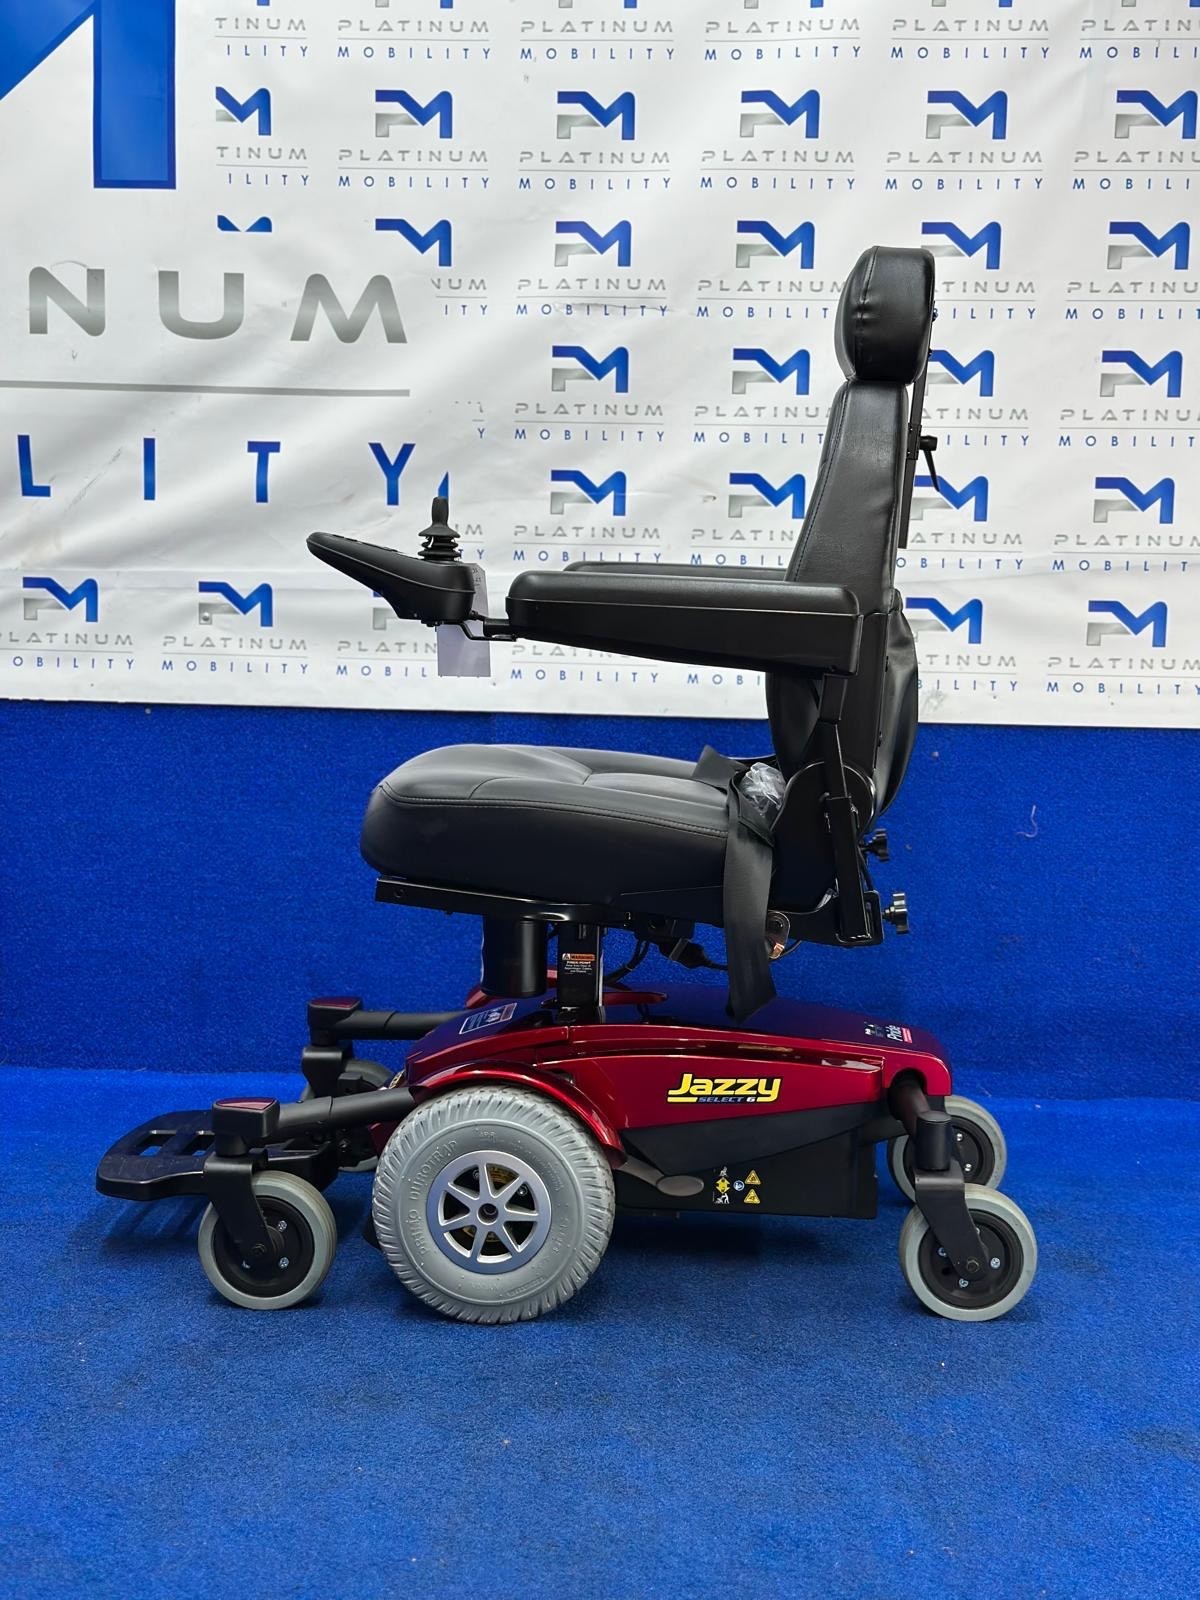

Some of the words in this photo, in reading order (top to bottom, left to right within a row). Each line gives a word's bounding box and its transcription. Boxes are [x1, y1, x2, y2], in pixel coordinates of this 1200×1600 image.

[338, 19, 489, 33] PLATINUM
[521, 20, 673, 33] PLATINUM
[705, 18, 860, 34] PLATINUM
[892, 19, 1048, 31] PLATINUM
[1081, 19, 1200, 31] PLATIN
[337, 46, 490, 59] MOBILITY
[520, 48, 674, 60] MOBILITY
[704, 46, 861, 61] MOBILITY
[890, 47, 1049, 59] MOBILITY
[338, 149, 488, 163] PLATINUM
[520, 151, 670, 164] PLATINUM
[701, 149, 854, 163] PLATINUM
[887, 150, 1042, 164] PLATINUM
[338, 176, 490, 189] MOBILITY
[519, 177, 671, 189] MOBILITY
[700, 177, 855, 189] MOBILITY
[885, 178, 1043, 189] MOBILITY
[517, 278, 666, 291] PLATINUM
[935, 281, 1035, 293] TINUM
[516, 304, 667, 316] MOBILITY
[515, 403, 663, 416] PLATINUM
[1060, 409, 1200, 422] PLATINU
[514, 428, 664, 440] MOBILITY
[514, 525, 660, 538] PLATINUM
[0, 631, 133, 648] LATINUM
[163, 636, 307, 650] PLATINUM
[918, 654, 1016, 666] TINUM
[162, 660, 308, 674] MOBILITY
[510, 668, 658, 683] MOBILITY
[667, 1073, 781, 1102] Jazzy
